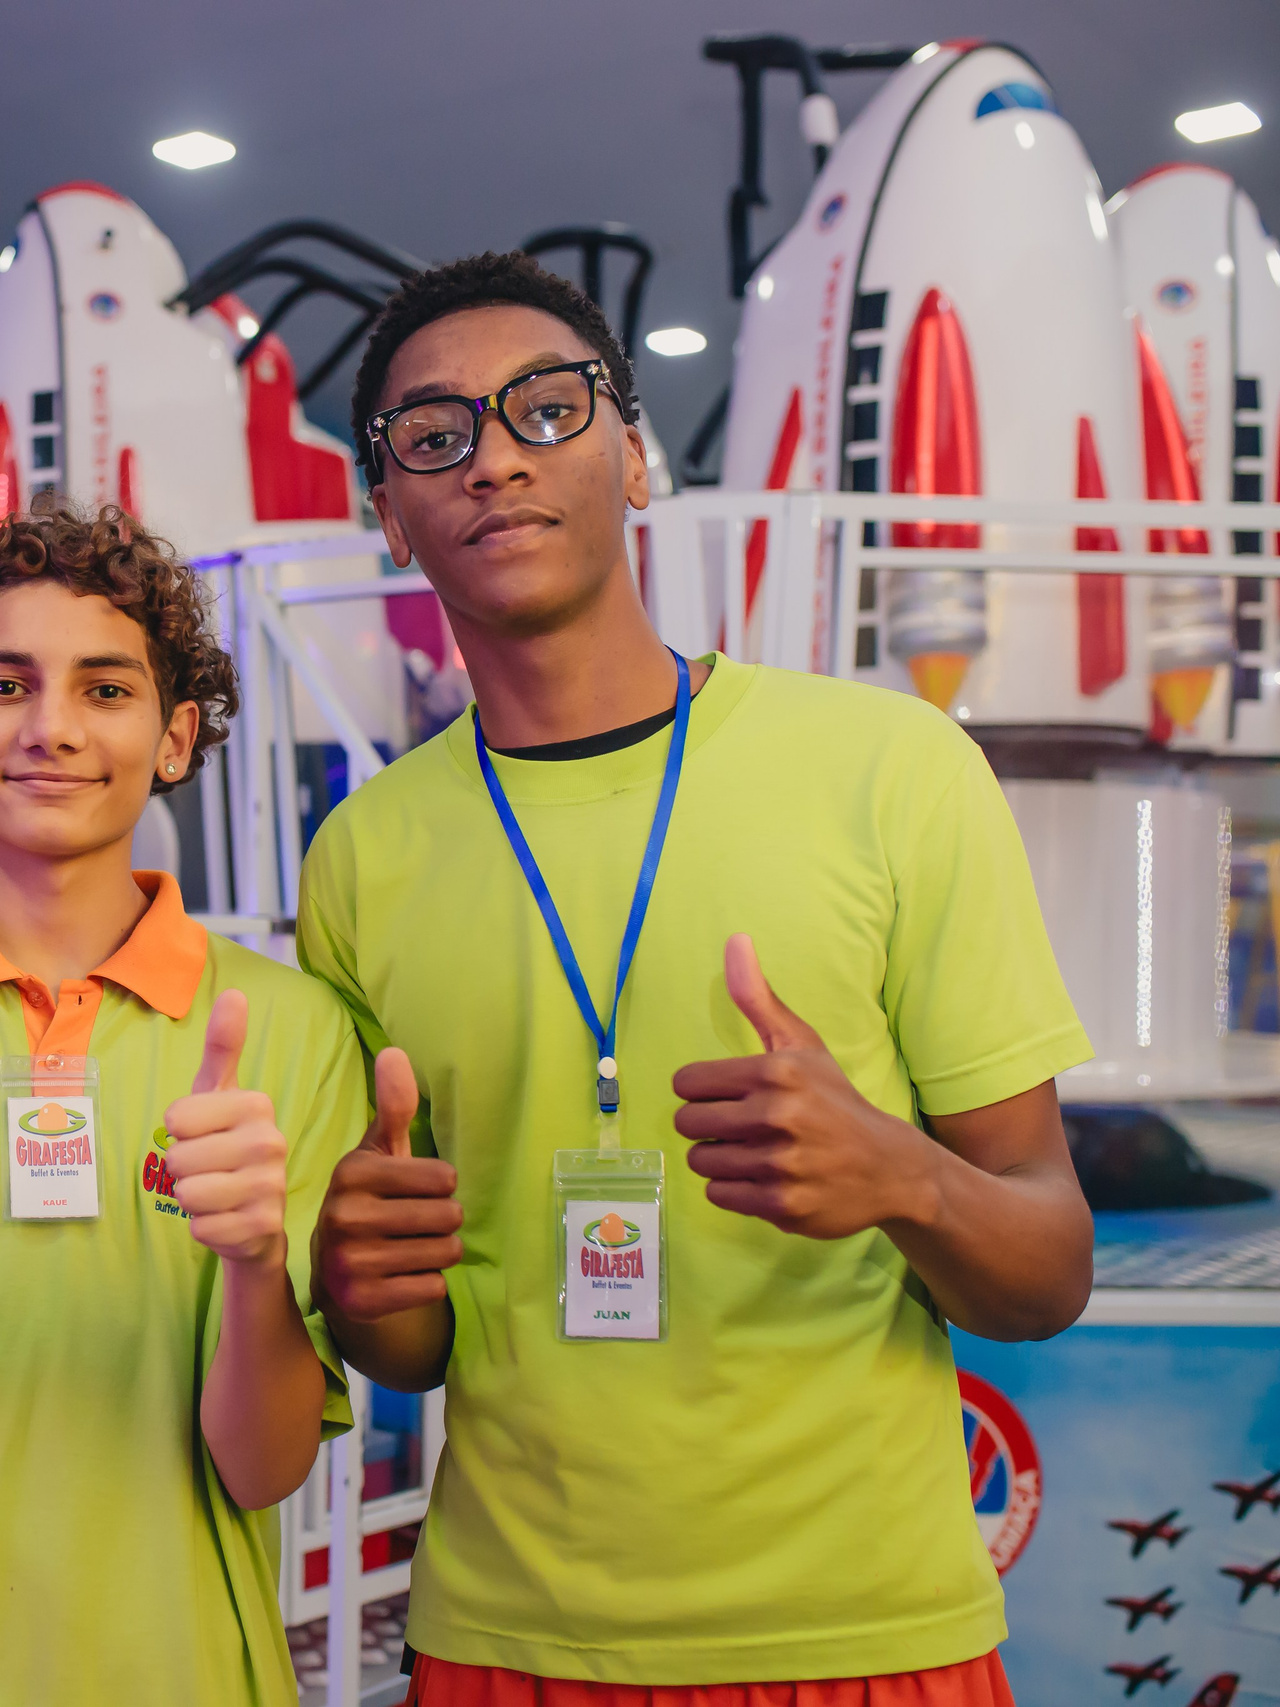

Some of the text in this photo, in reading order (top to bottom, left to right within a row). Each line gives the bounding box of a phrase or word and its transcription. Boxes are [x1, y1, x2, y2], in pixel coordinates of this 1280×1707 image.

[15, 1134, 93, 1167] GIRAFESTA
[30, 1168, 79, 1178] Buffet & Eventos
[154, 1200, 180, 1216] Buffet
[580, 1246, 645, 1279] GIRAFESTA
[593, 1310, 631, 1320] JUAN
[984, 1468, 1040, 1572] UMAÇA
